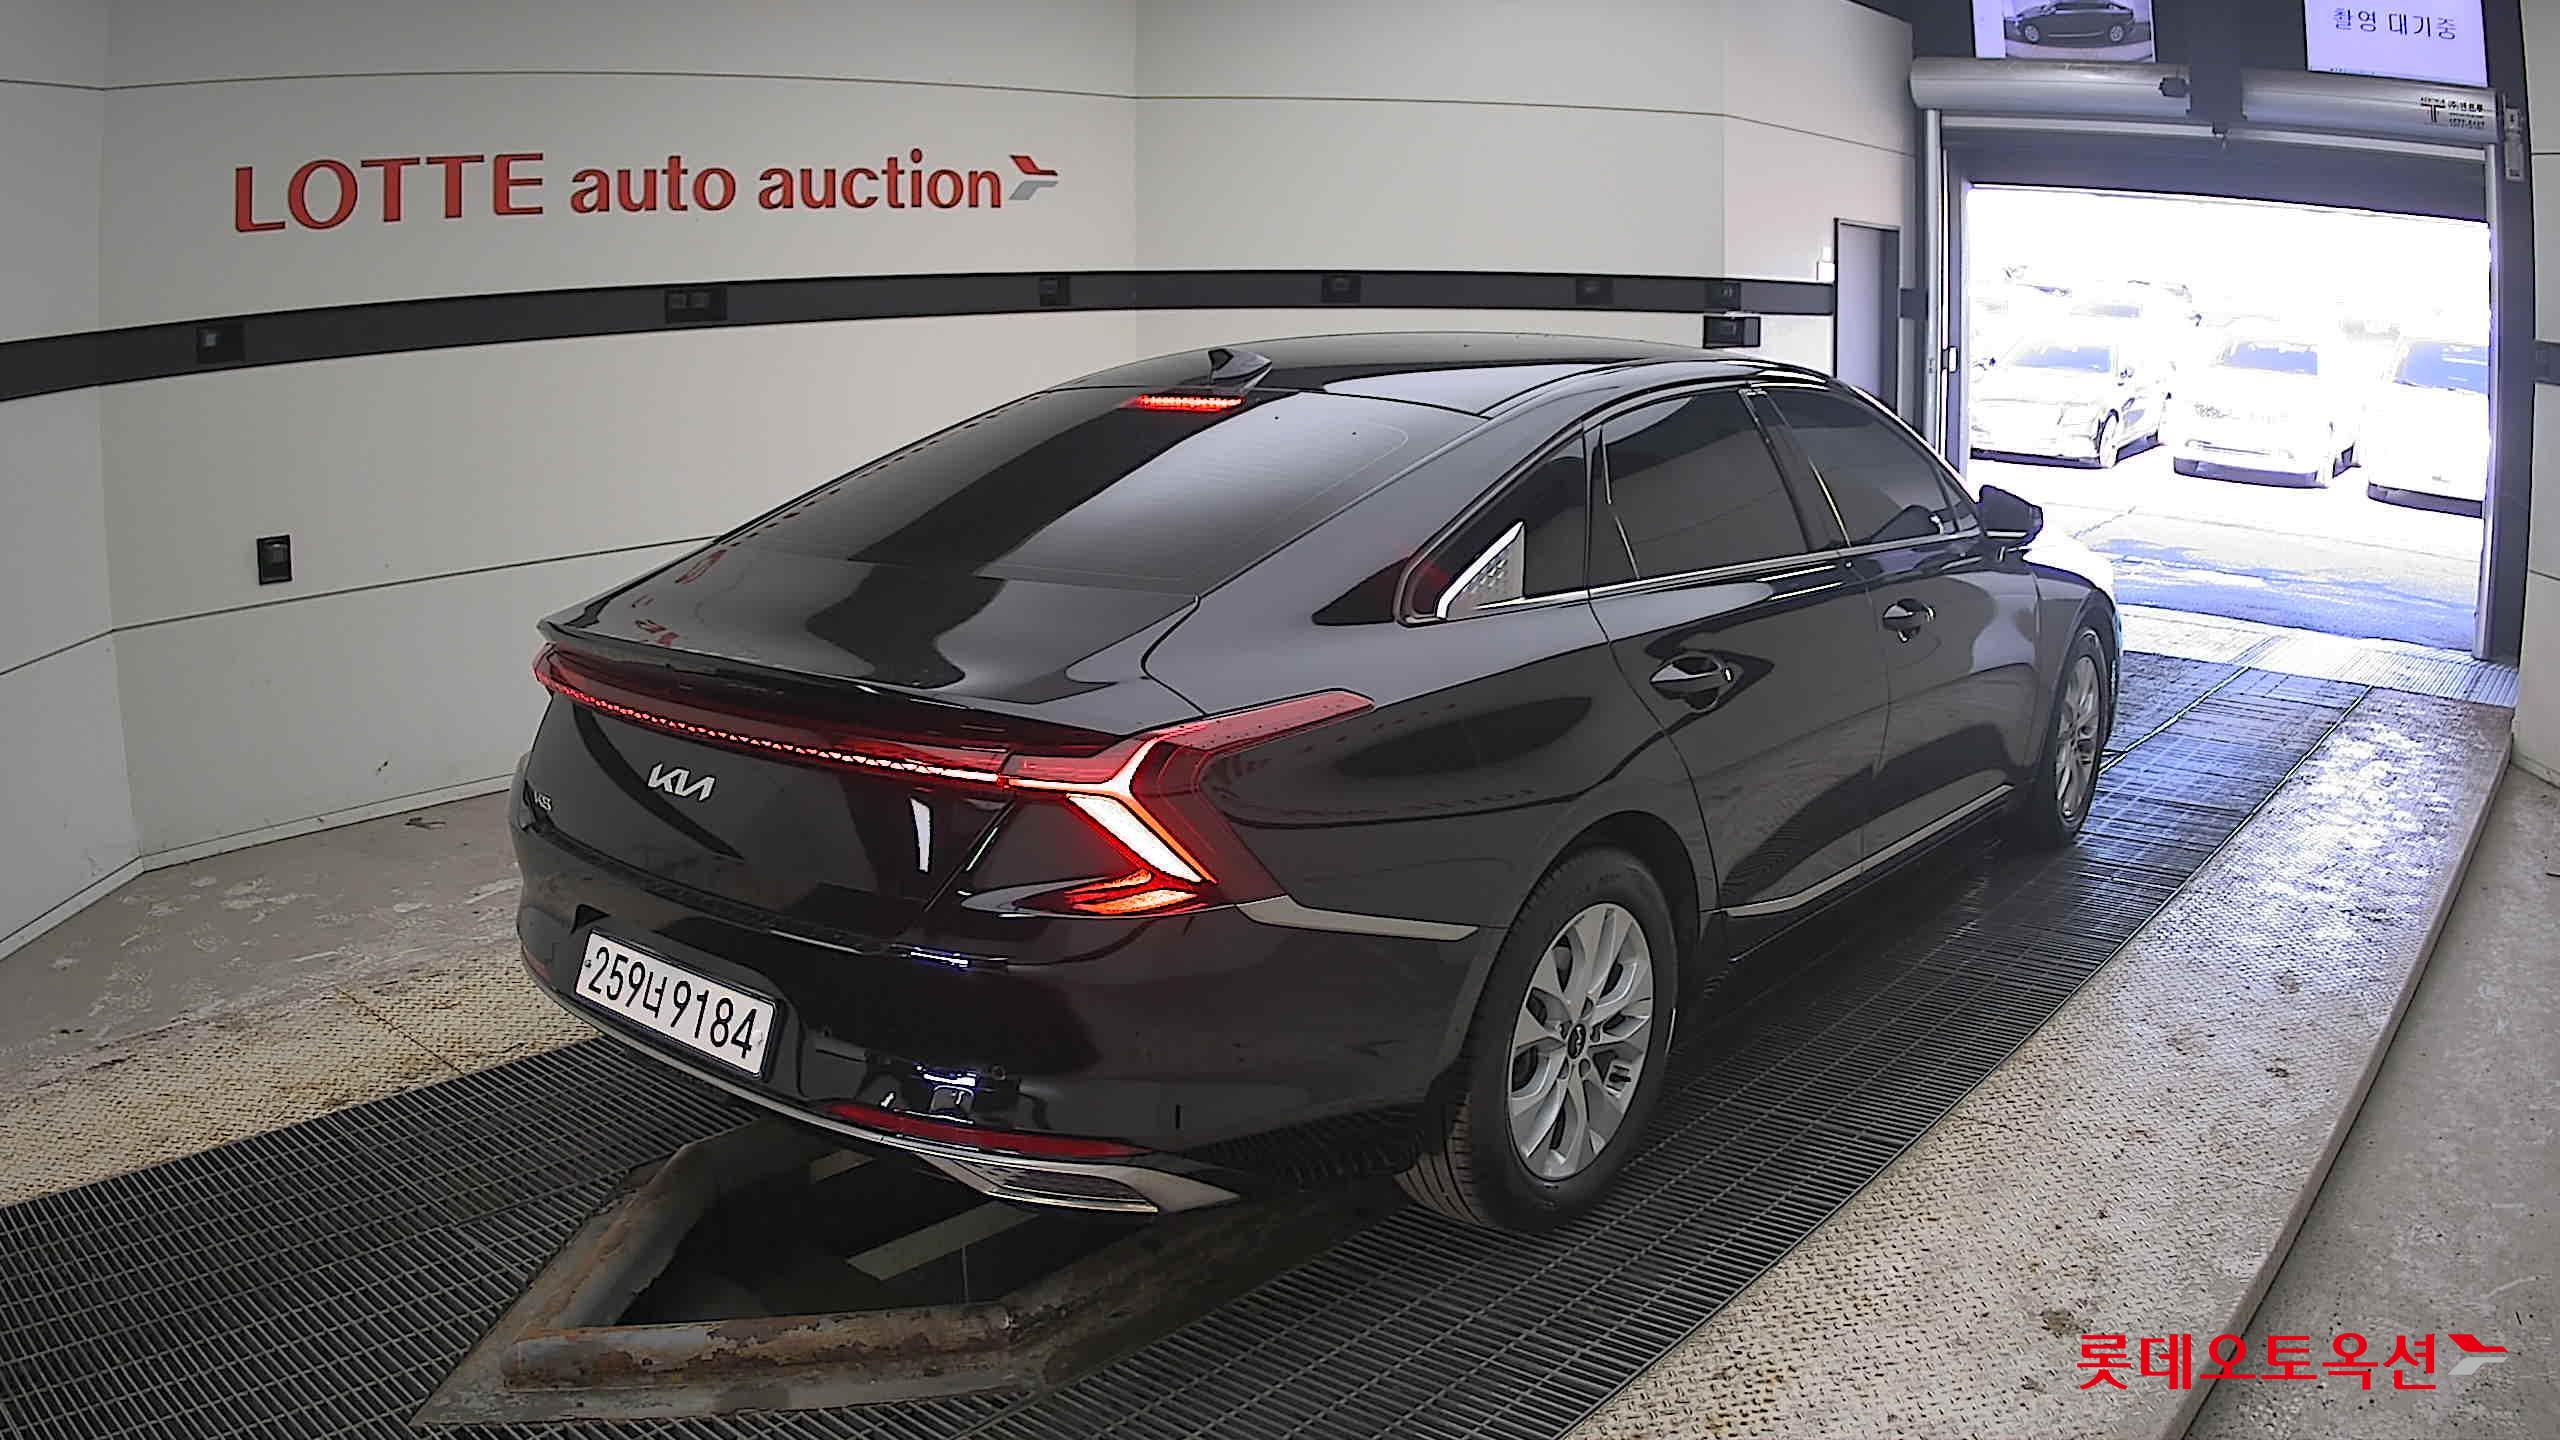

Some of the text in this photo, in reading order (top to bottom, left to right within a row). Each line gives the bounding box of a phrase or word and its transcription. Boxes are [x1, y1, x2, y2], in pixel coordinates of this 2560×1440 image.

[2388, 13, 2457, 41] 대기중
[235, 148, 1002, 233] LOTTE auto auction
[647, 762, 716, 801] KIA
[588, 946, 758, 1059] 259너9184
